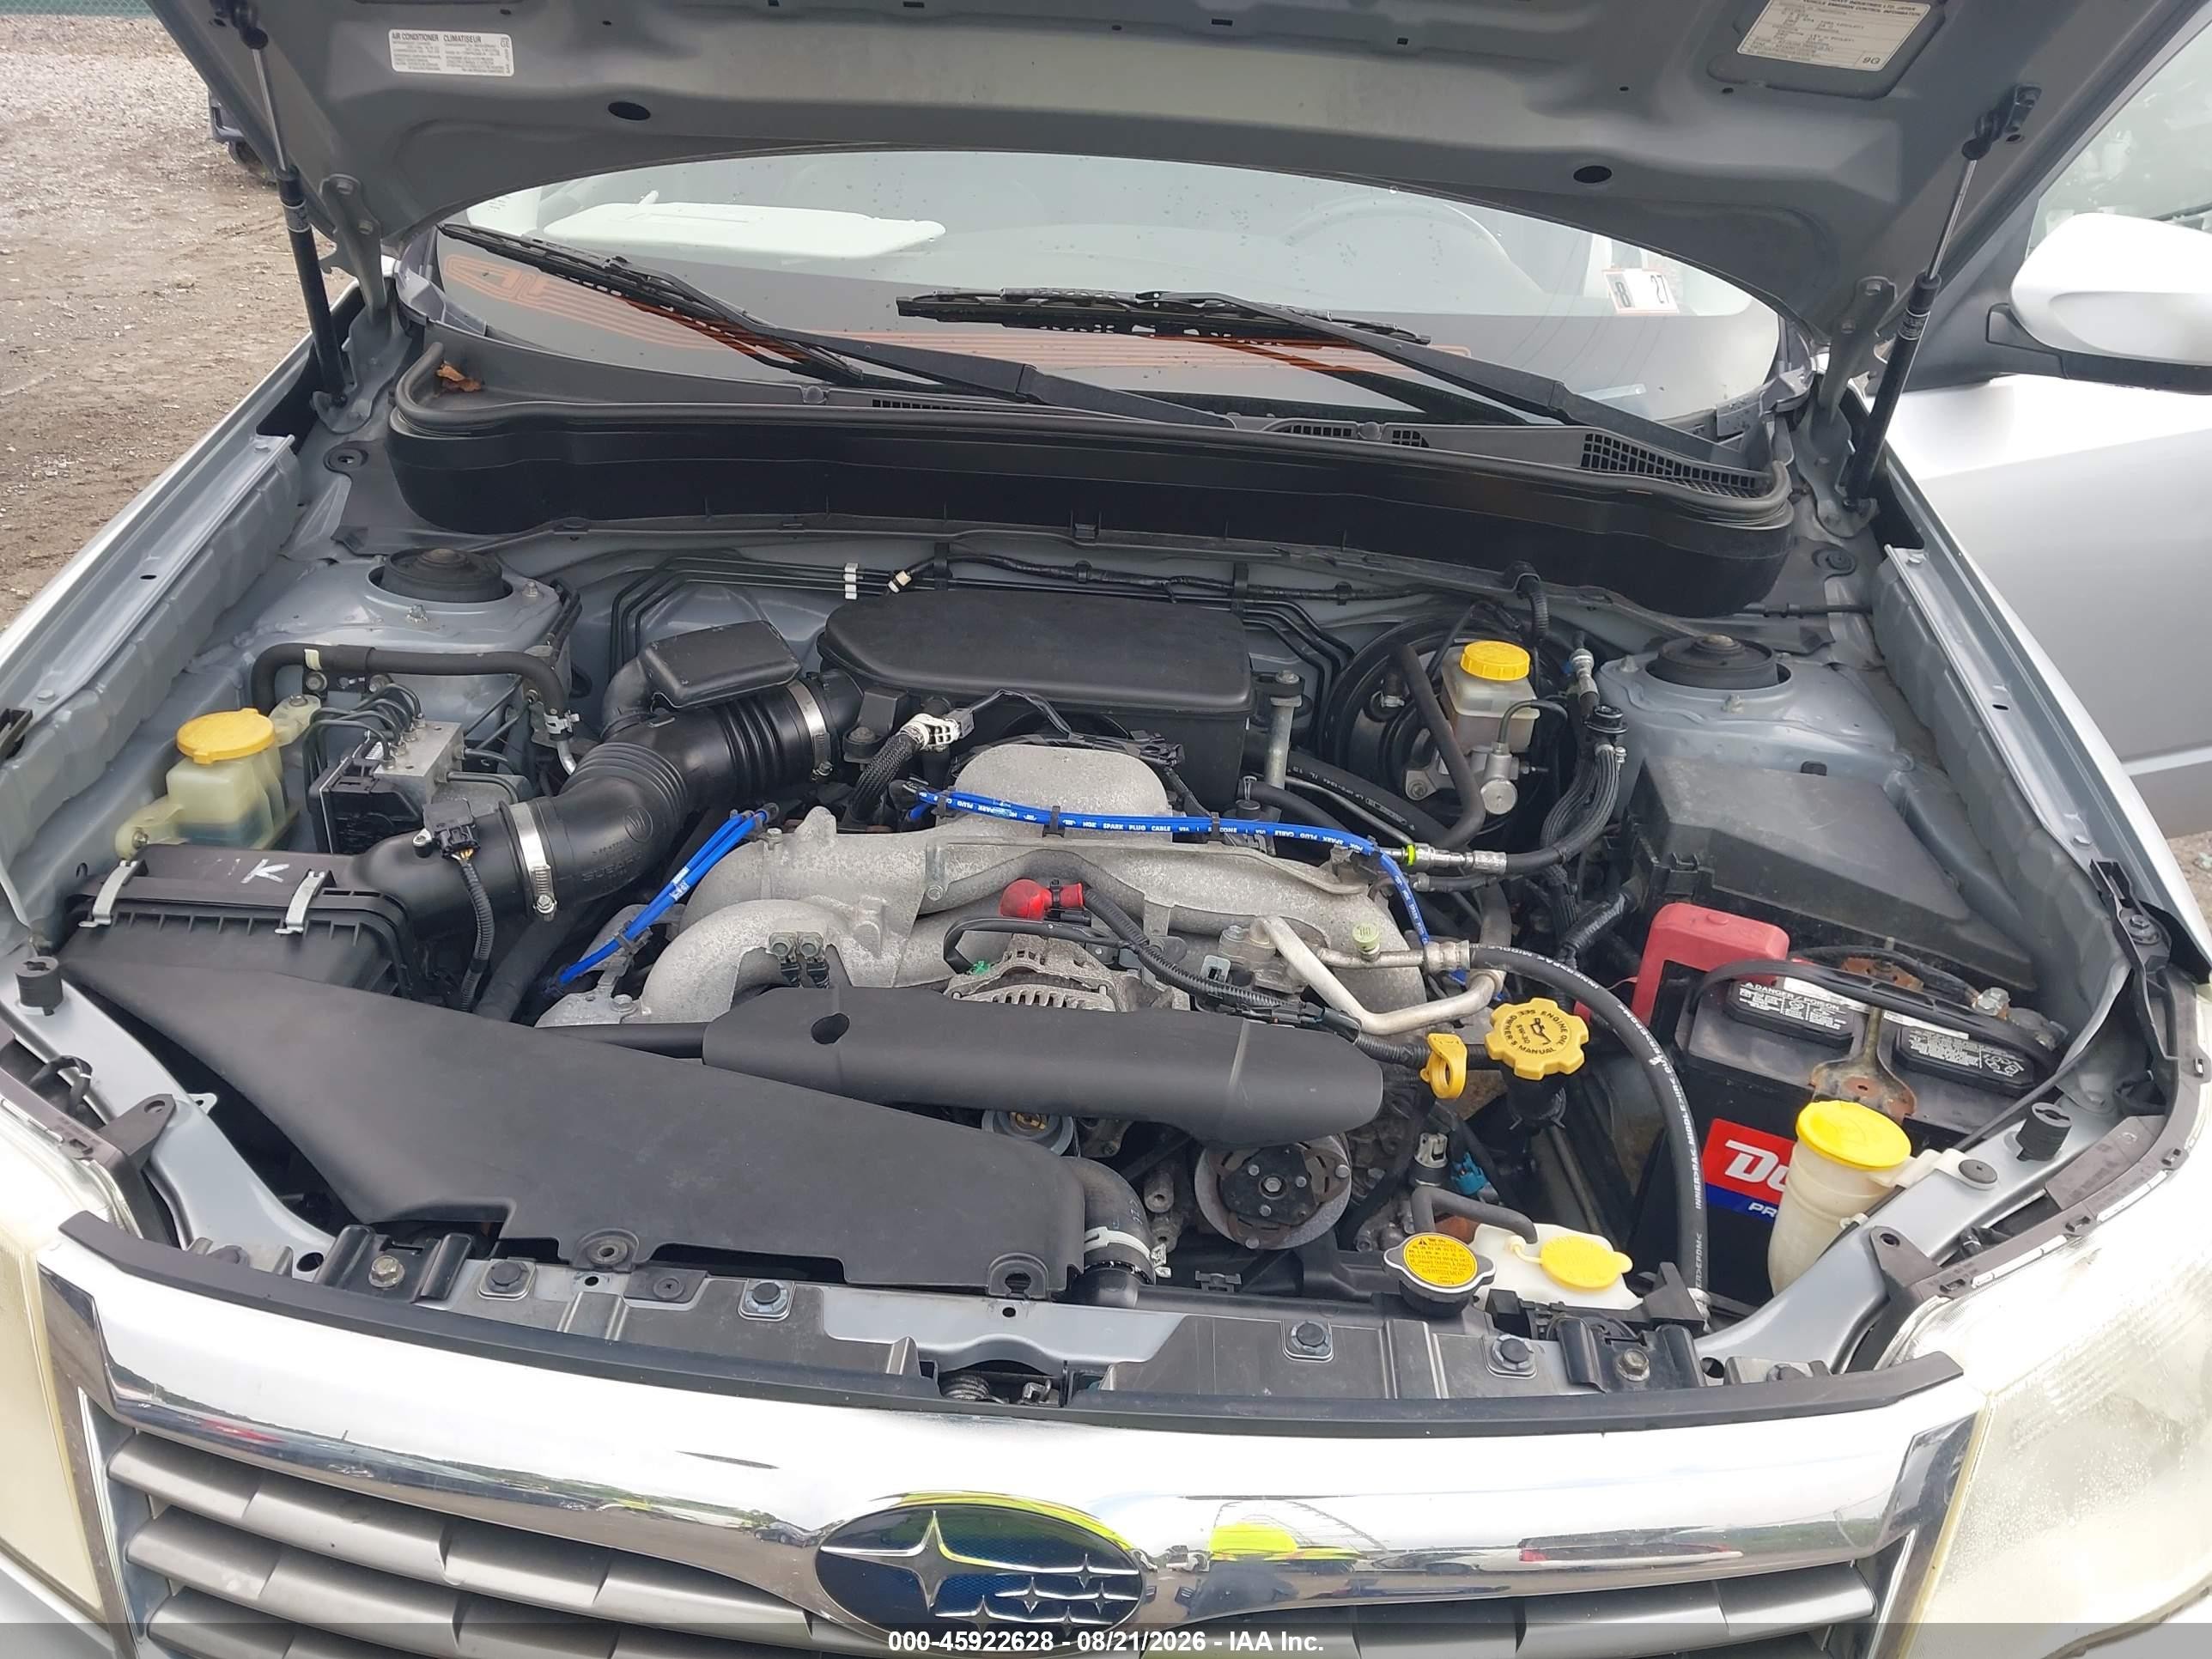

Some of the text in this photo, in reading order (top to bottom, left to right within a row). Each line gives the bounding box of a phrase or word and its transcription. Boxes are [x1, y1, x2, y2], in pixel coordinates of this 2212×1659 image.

[443, 33, 482, 43] CLIMATISEUR
[1650, 274, 1670, 304] 27
[1103, 823, 1124, 831] SPARK
[1128, 823, 1146, 832] PLUG
[1322, 836, 1345, 846] SPARK
[240, 858, 290, 884] K
[1540, 1010, 1569, 1046] ENGINE OIL
[1518, 1044, 1557, 1055] MANUAL
[1748, 1201, 1778, 1218] PR
